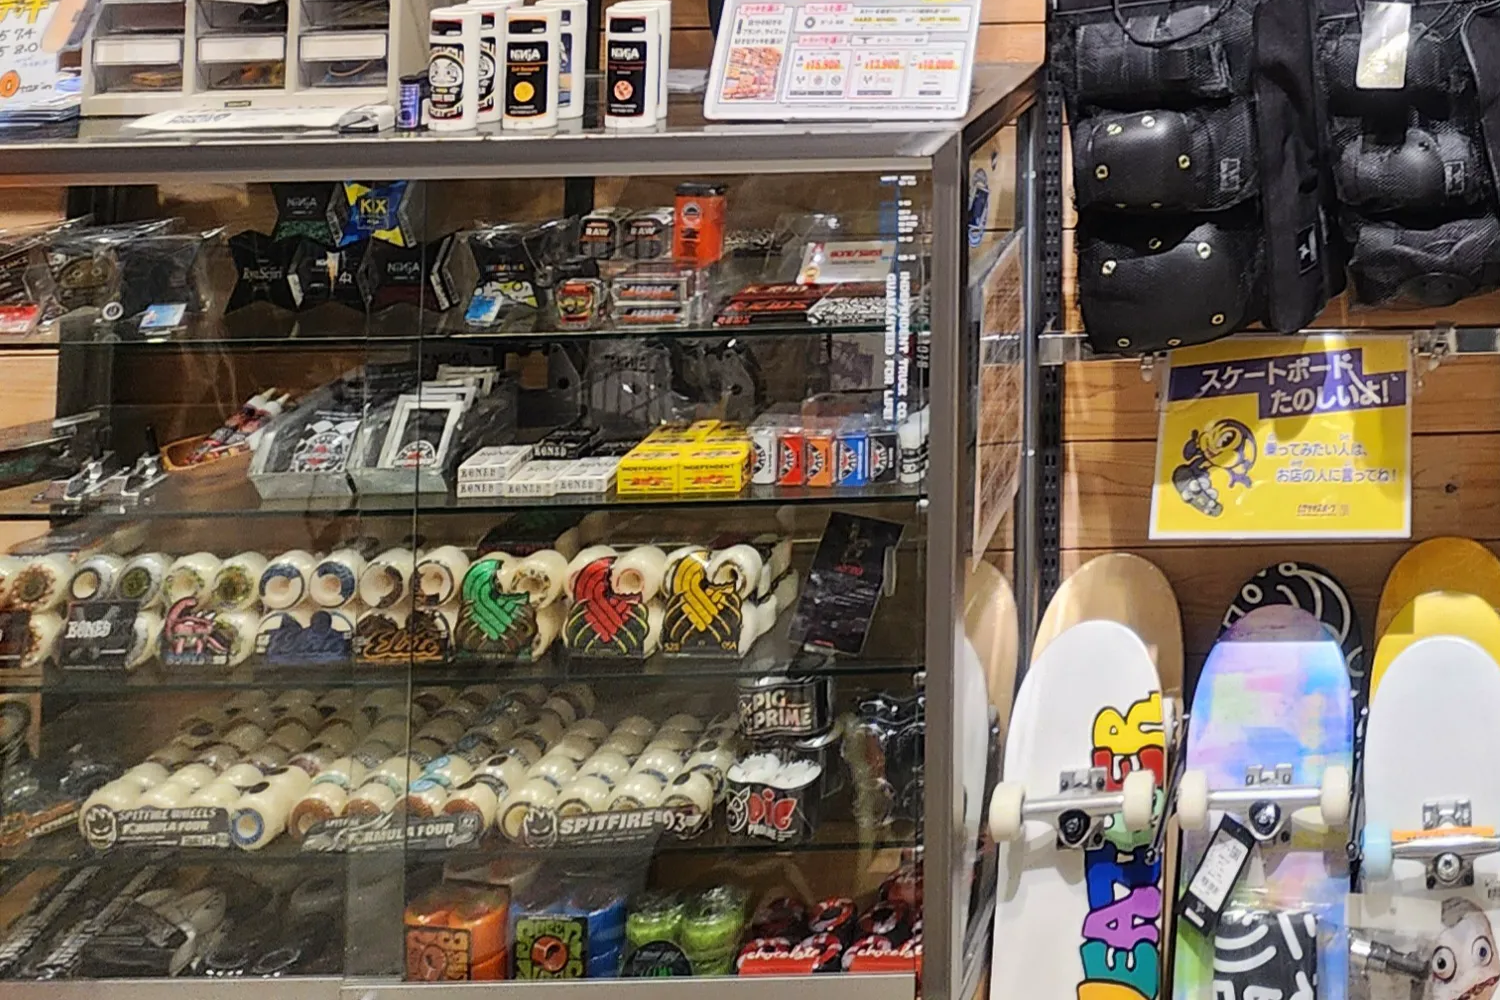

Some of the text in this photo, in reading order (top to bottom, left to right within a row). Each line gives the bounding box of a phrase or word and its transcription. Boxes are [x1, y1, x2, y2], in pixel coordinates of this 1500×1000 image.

[1201, 352, 1354, 392] スケートボード
[1270, 380, 1390, 415] たのしいよ!
[753, 689, 787, 709] PIG
[753, 706, 812, 727] PRIME
[417, 822, 454, 837] FOUR
[559, 811, 653, 835] SPITFIRE
